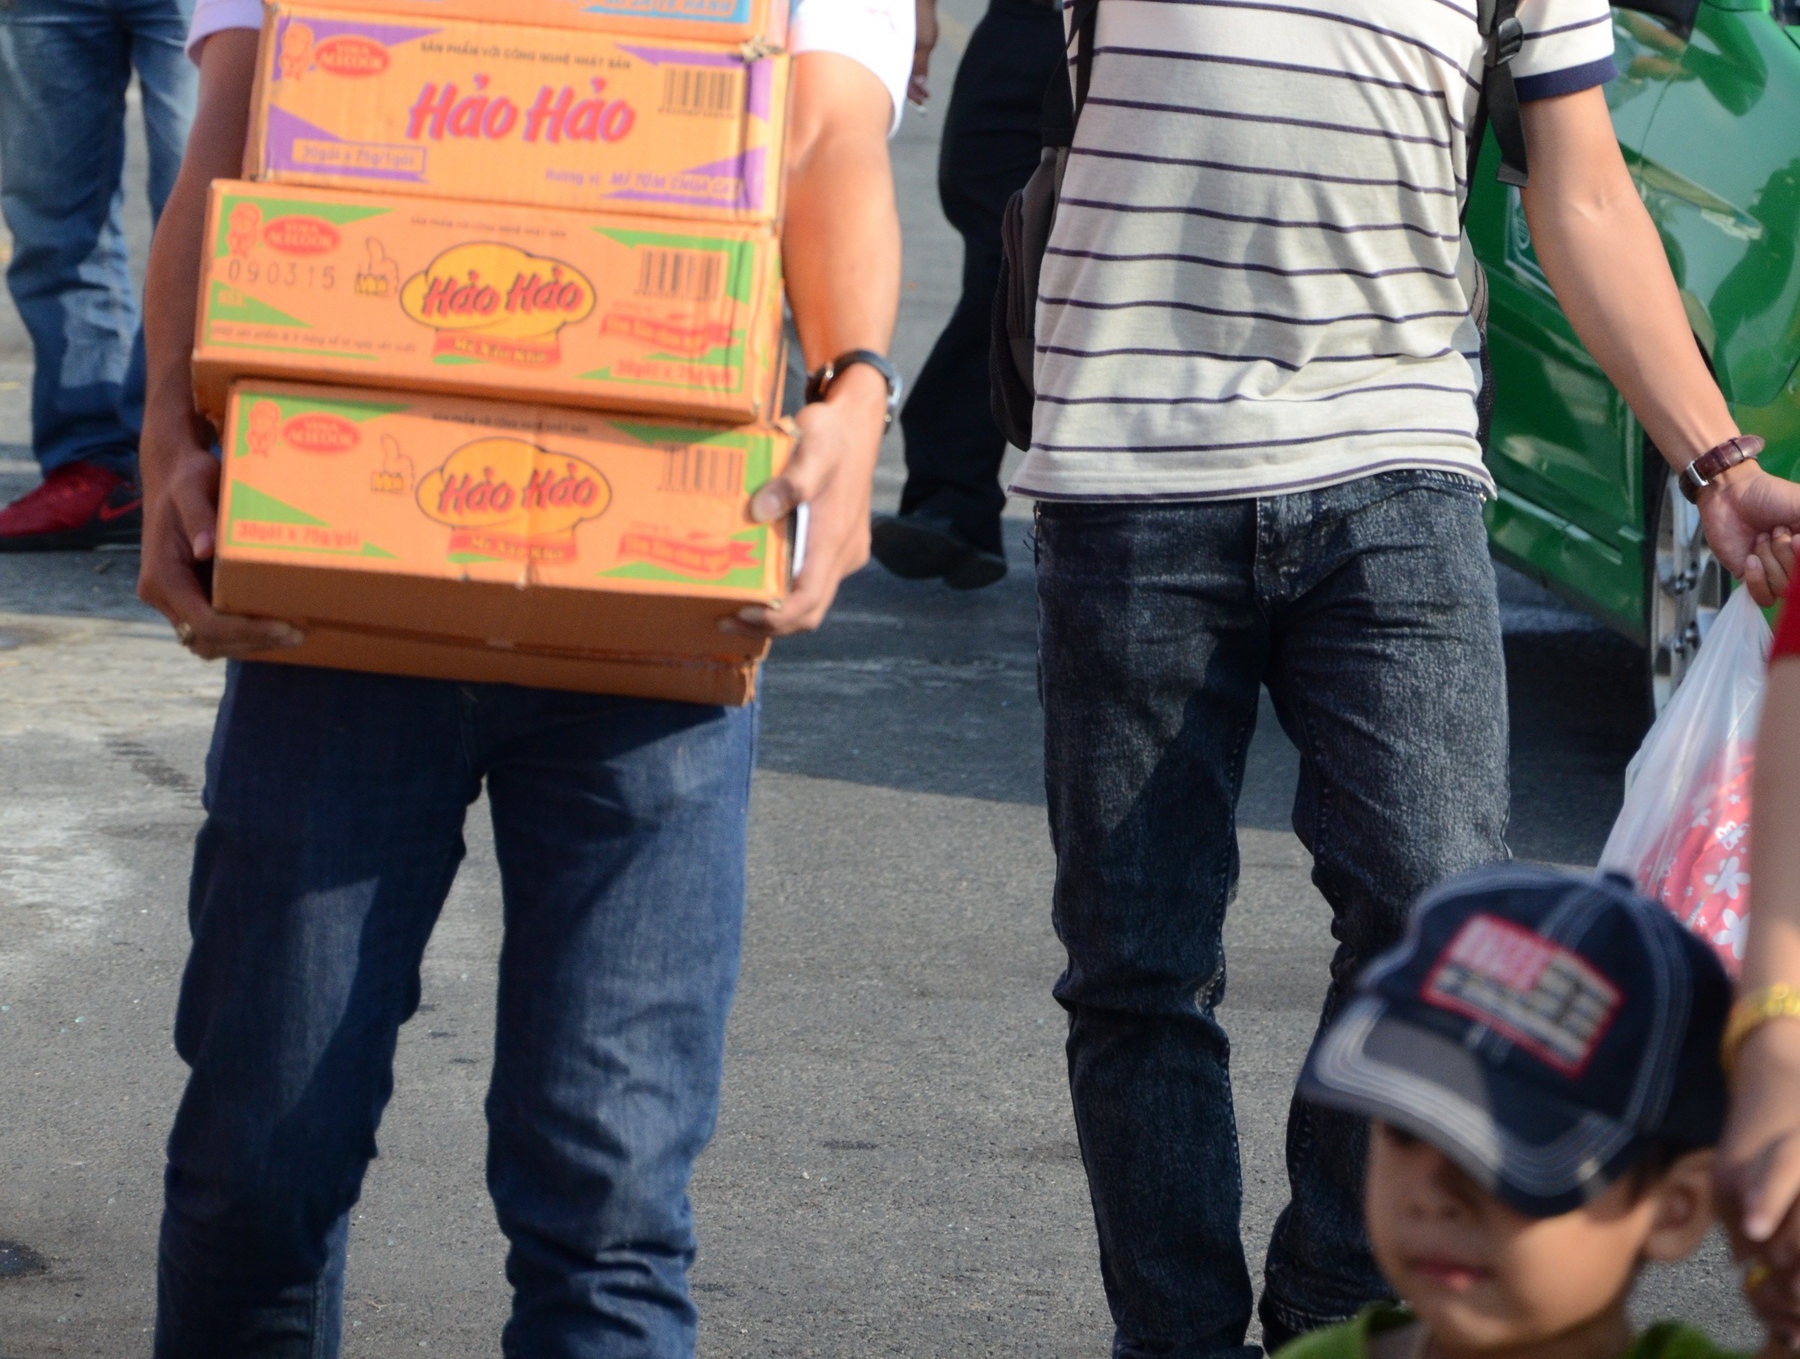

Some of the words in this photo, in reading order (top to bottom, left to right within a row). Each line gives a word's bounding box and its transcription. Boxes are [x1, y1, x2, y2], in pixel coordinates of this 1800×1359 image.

[406, 73, 519, 141] Hảo
[523, 76, 636, 144] Hảo
[421, 270, 499, 318] Hảo
[505, 266, 585, 314] Hảo
[437, 466, 515, 515] Hảo
[521, 462, 599, 510] Hảo
